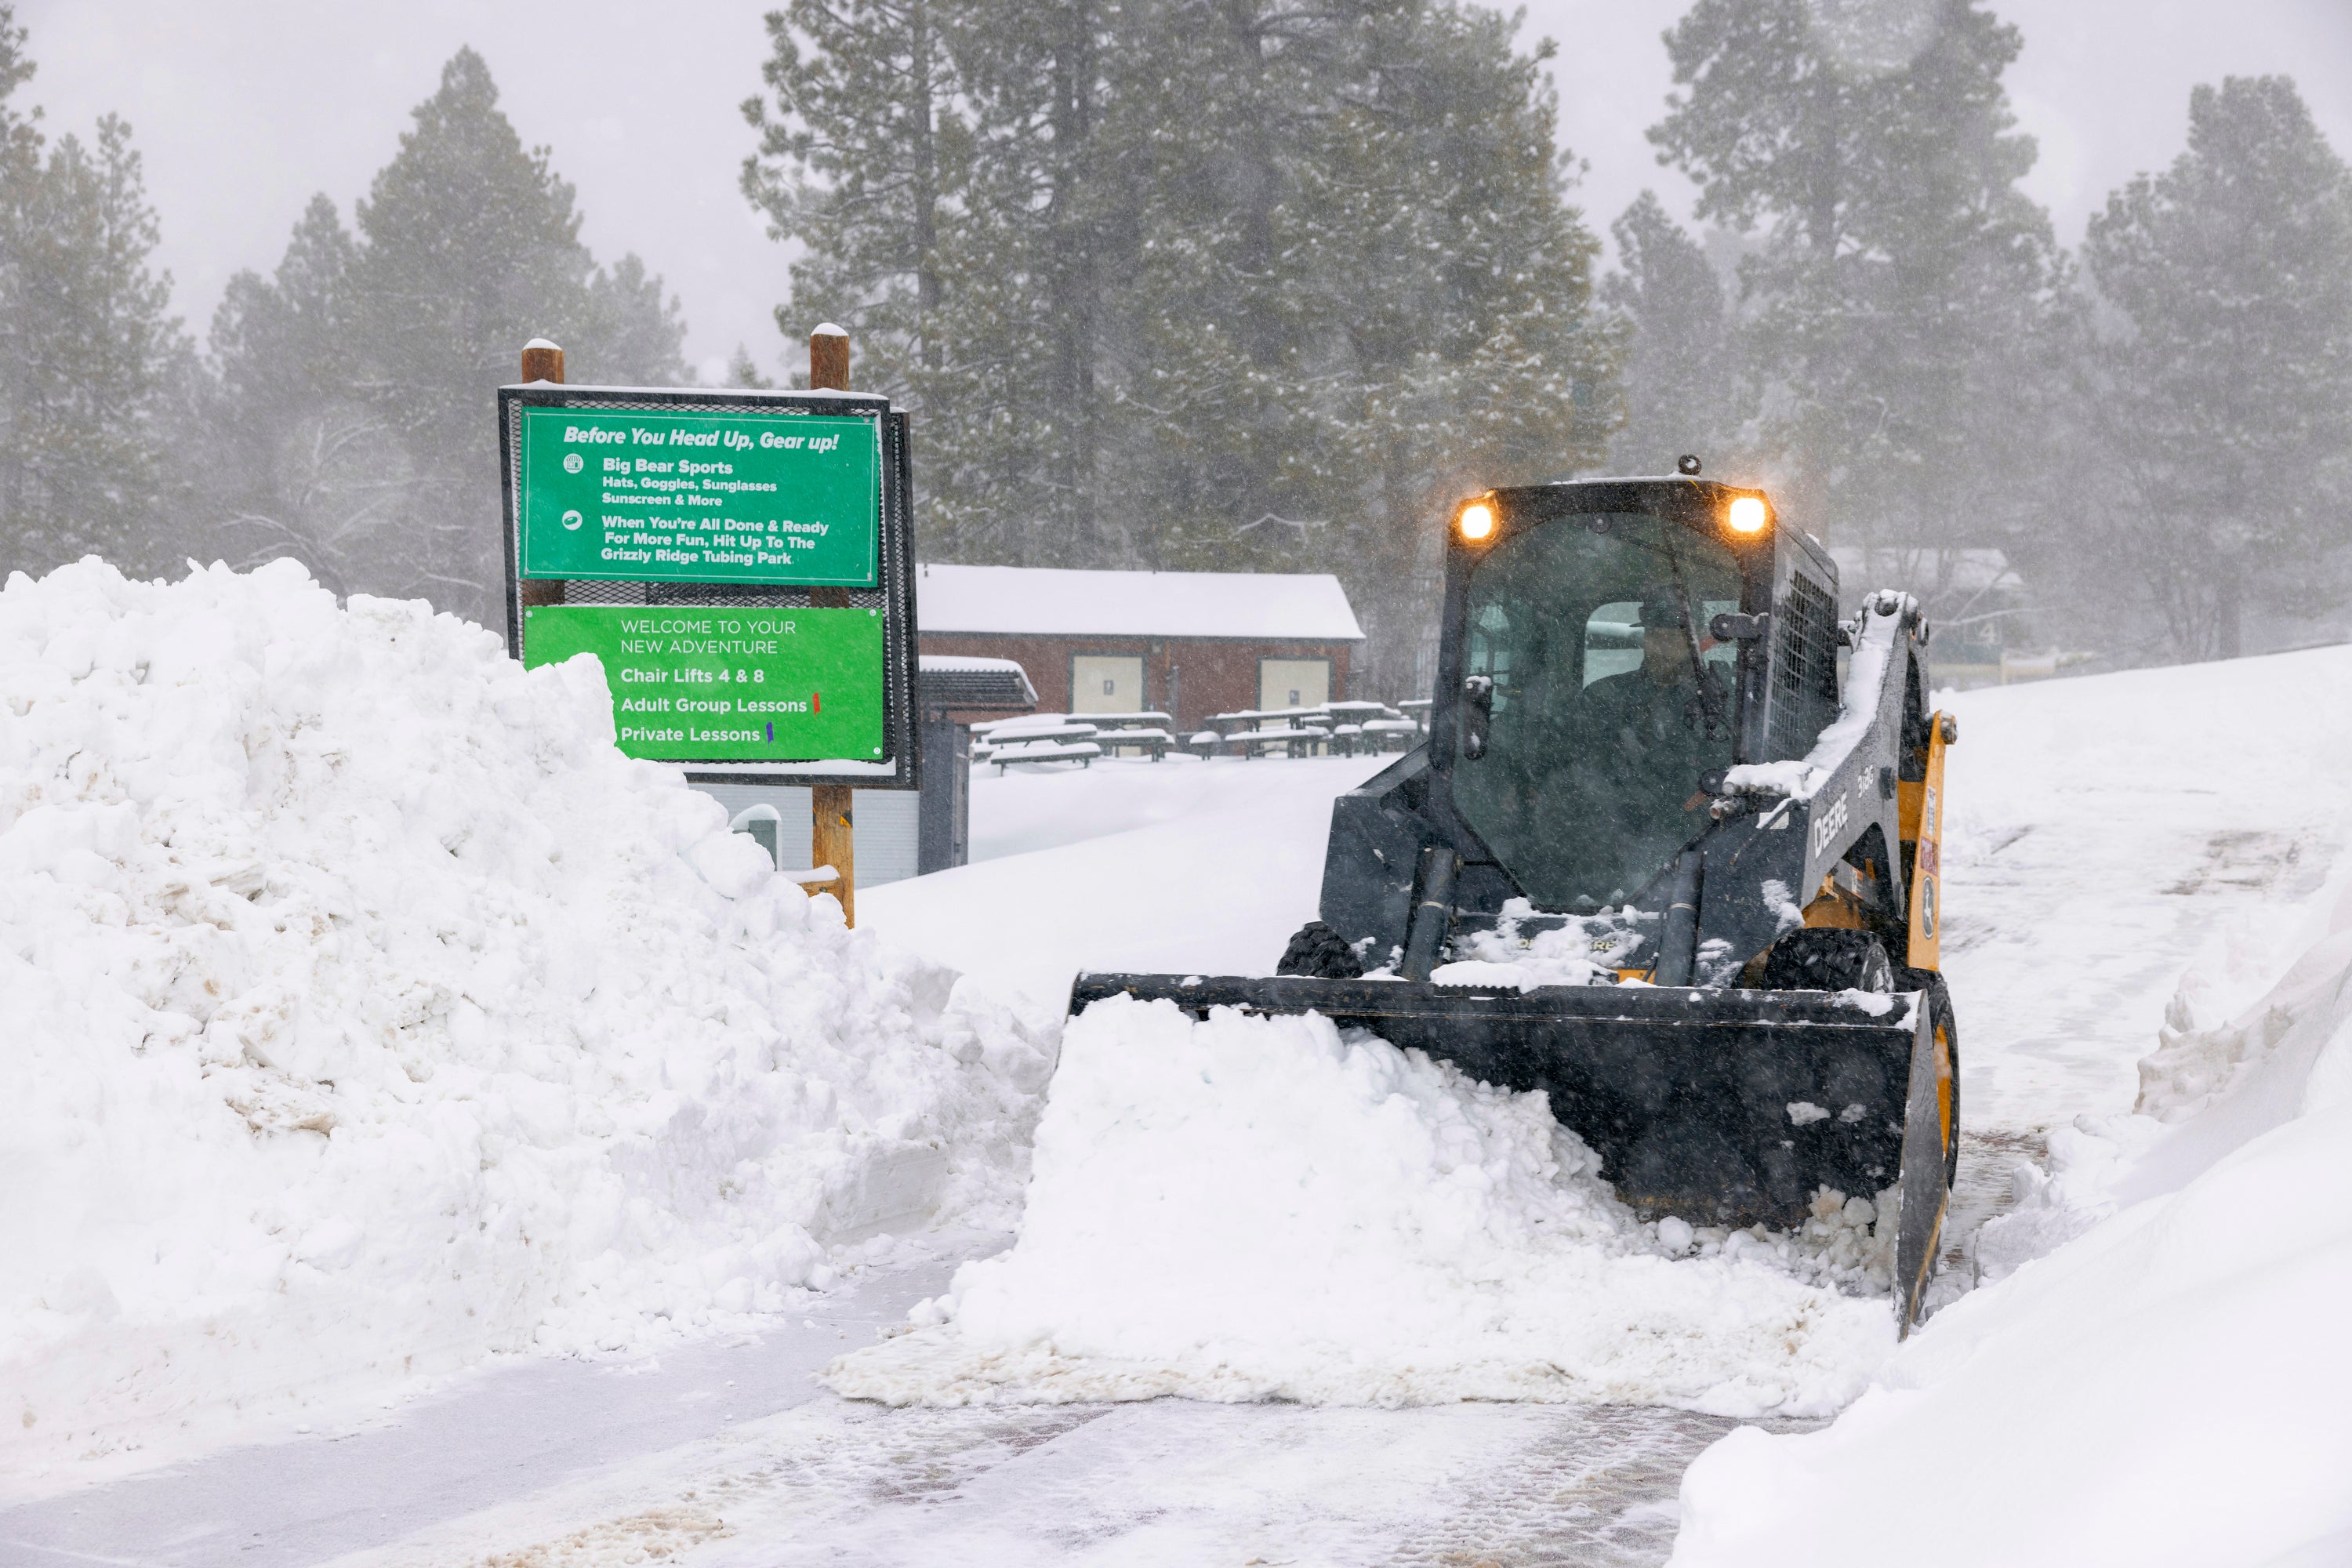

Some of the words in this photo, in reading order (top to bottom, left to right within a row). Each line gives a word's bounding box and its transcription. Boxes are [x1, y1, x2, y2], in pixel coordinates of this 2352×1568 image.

[564, 426, 626, 445] Before
[631, 427, 666, 445] You
[669, 429, 720, 447] Head
[724, 430, 755, 452] Up,
[760, 431, 805, 450] Gear
[808, 434, 840, 455] up!
[603, 456, 631, 475] Big
[635, 458, 674, 473] Bear
[678, 459, 733, 477] Sports
[602, 476, 638, 490] Hats,
[641, 477, 699, 492] Goggles,
[702, 479, 777, 493] Sunglasses
[602, 492, 671, 506] Sunscreen
[674, 494, 684, 506] &
[688, 495, 723, 506] More
[601, 515, 644, 528] When
[648, 517, 696, 530] You’re
[699, 517, 720, 530] All
[724, 518, 764, 532] Done
[767, 520, 779, 532] &
[782, 520, 829, 536] Ready
[604, 532, 630, 544] For
[633, 532, 672, 546] More
[676, 533, 709, 548] Fun,
[713, 534, 736, 547] Hit
[740, 535, 762, 550] Up
[765, 535, 784, 548] To
[787, 536, 815, 549] The
[601, 547, 652, 564] Grizzly
[655, 548, 699, 565] Ridge
[702, 550, 753, 567] Tubing
[757, 551, 792, 564] Park
[621, 620, 711, 633] WELCOME
[717, 620, 741, 634] TO
[746, 620, 796, 634] YOUR
[621, 640, 663, 653] NEW
[669, 640, 778, 654] ADVENTURE
[620, 668, 669, 683] Chair
[674, 668, 713, 683] Lifts
[718, 669, 731, 683] 4
[735, 669, 748, 683] &
[753, 669, 764, 683] 8
[620, 697, 670, 712] Adult
[676, 698, 731, 716] Group
[737, 699, 808, 713] Lessons
[620, 726, 684, 742] Private
[690, 727, 760, 742] Lessons
[1814, 790, 1848, 858] DEERE
